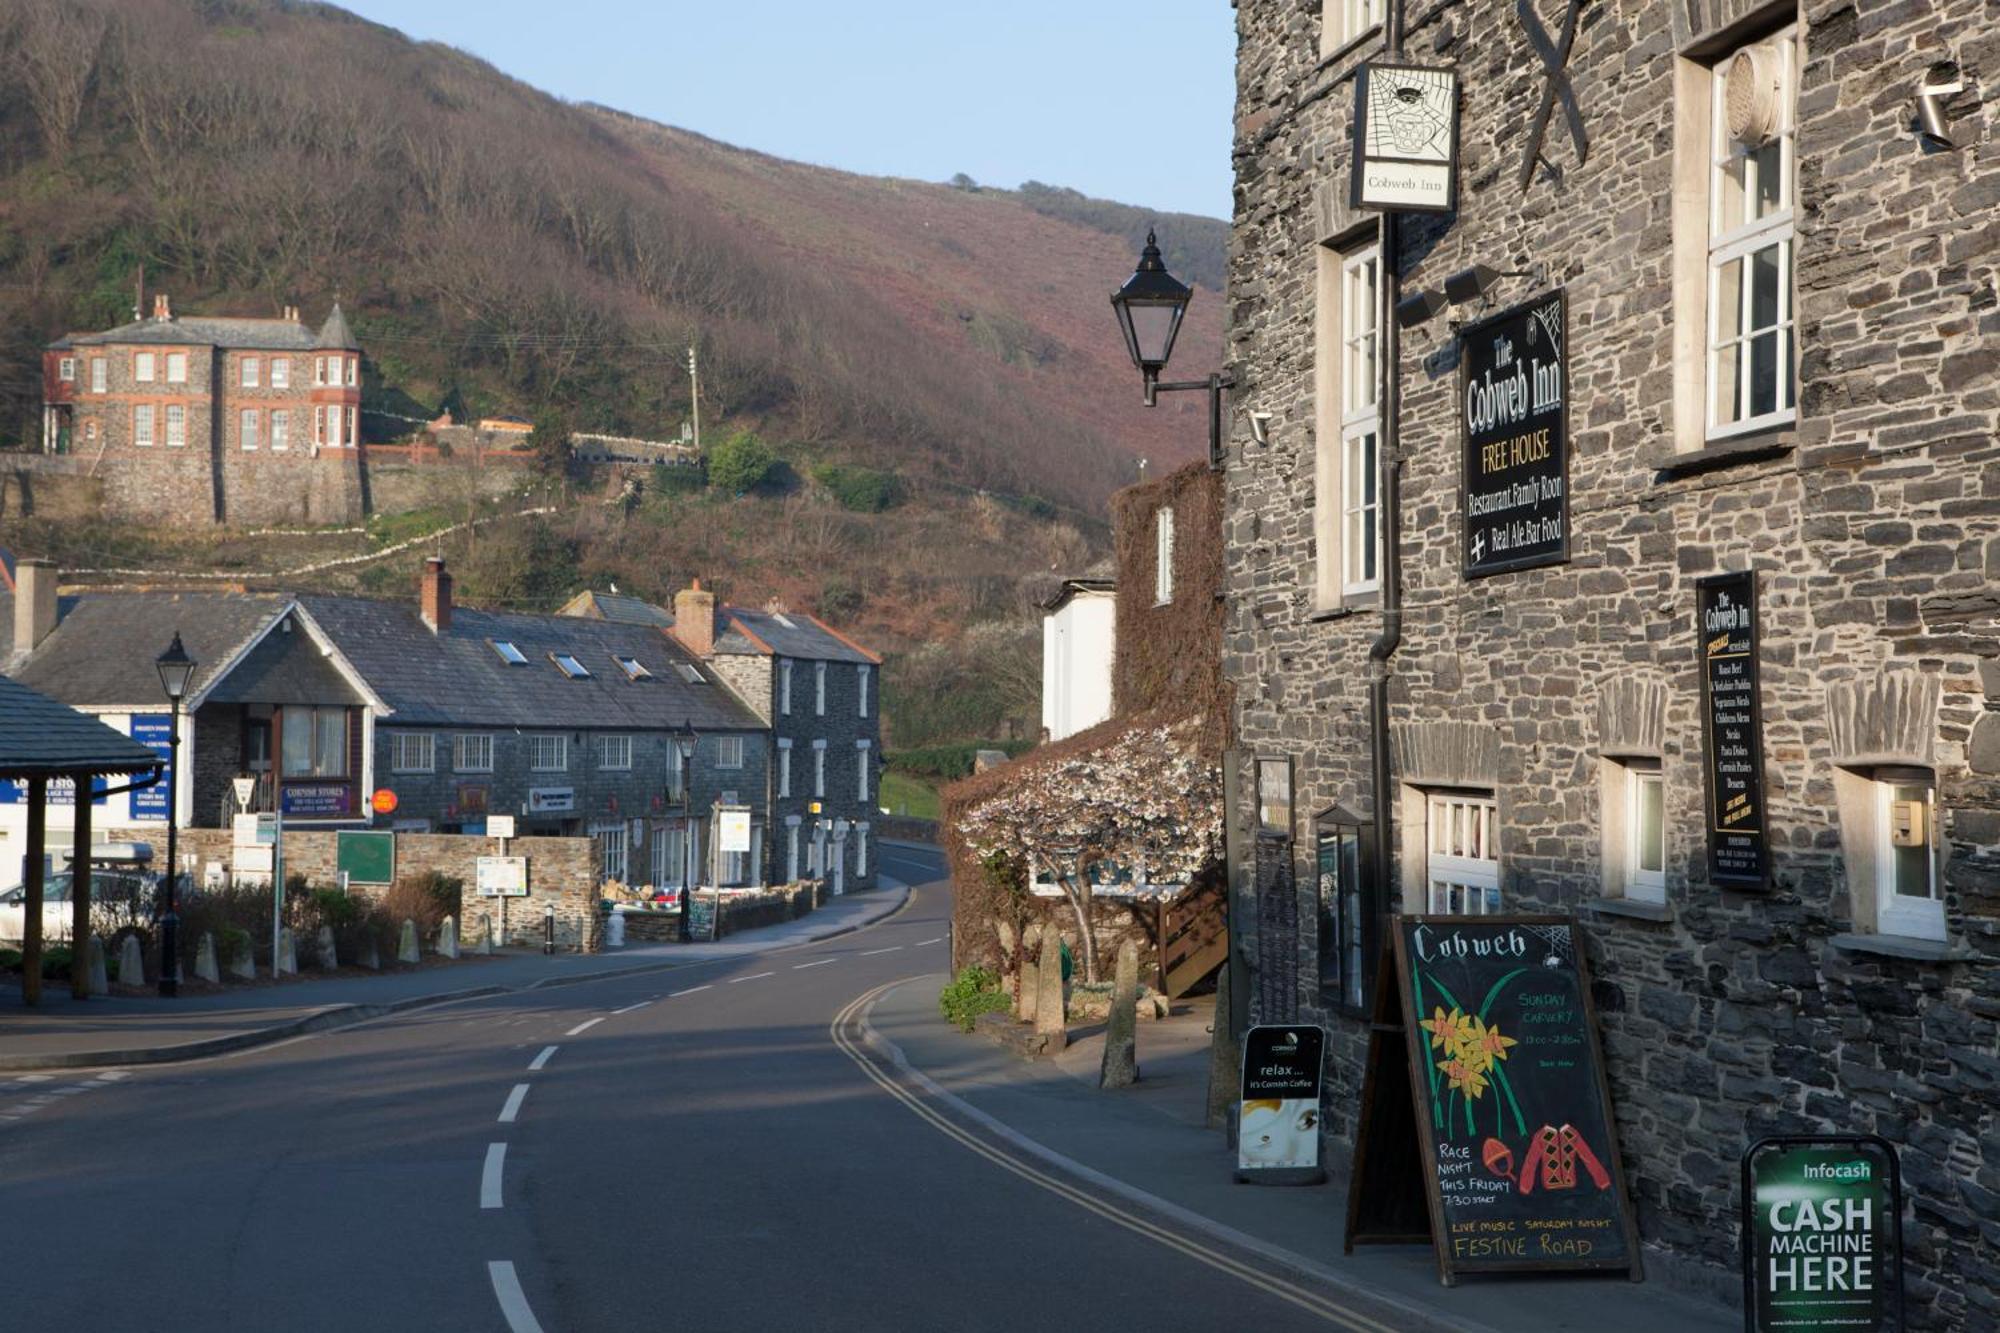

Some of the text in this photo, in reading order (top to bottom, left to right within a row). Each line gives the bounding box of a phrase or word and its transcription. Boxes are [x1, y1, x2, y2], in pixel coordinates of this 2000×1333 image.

[1368, 175, 1442, 191] Cobweb Inn
[1467, 357, 1561, 434] Cobweb Inn
[1482, 429, 1551, 474] FREE HOUSE
[1492, 522, 1509, 551] Real
[1542, 512, 1562, 541] Food
[1718, 591, 1729, 608] The
[1706, 603, 1737, 631] Cobweb
[1413, 924, 1527, 963] Cobweb
[1518, 993, 1566, 1007] SUNDAY
[1261, 1080, 1289, 1088] Cornish
[1289, 1079, 1313, 1088] Coffee
[1440, 1144, 1470, 1159] RACE
[1437, 1162, 1473, 1176] NIGHT
[1803, 1162, 1871, 1179] Infocash
[1440, 1178, 1510, 1193] THIS FRIDAY
[1769, 1198, 1872, 1232] CASH
[1452, 1222, 1475, 1233] LIVE
[1480, 1221, 1516, 1232] MUSIC
[1524, 1220, 1574, 1230] SATURDAY
[1454, 1233, 1593, 1258] FESTIVE ROAD
[1770, 1234, 1872, 1254] MACHINE
[1770, 1256, 1872, 1292] HERE
